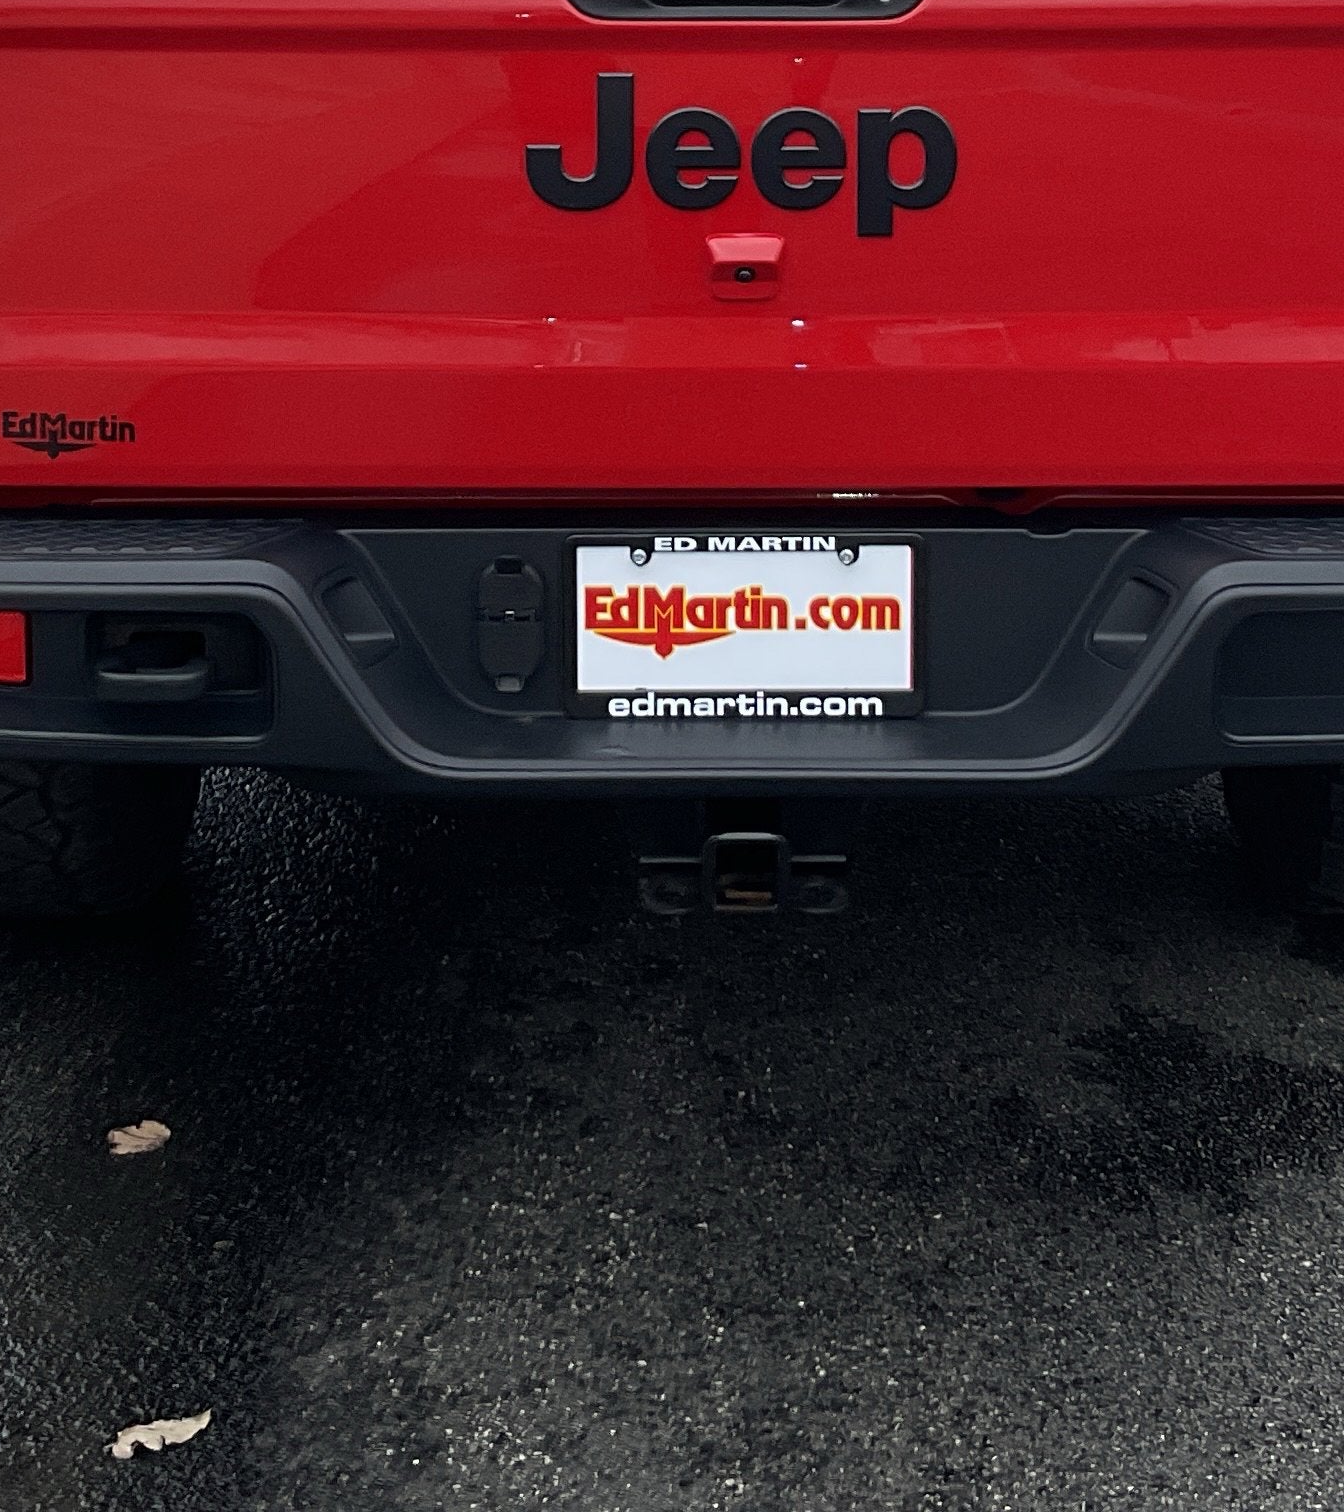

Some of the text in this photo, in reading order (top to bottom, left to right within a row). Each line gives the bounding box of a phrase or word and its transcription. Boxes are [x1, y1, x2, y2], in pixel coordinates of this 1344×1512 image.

[525, 71, 957, 238] Jeep
[2, 411, 136, 451] EdMartin
[654, 536, 837, 552] ED MARTIN
[583, 584, 902, 643] EdMartin.com
[607, 691, 884, 717] edmartin.com
